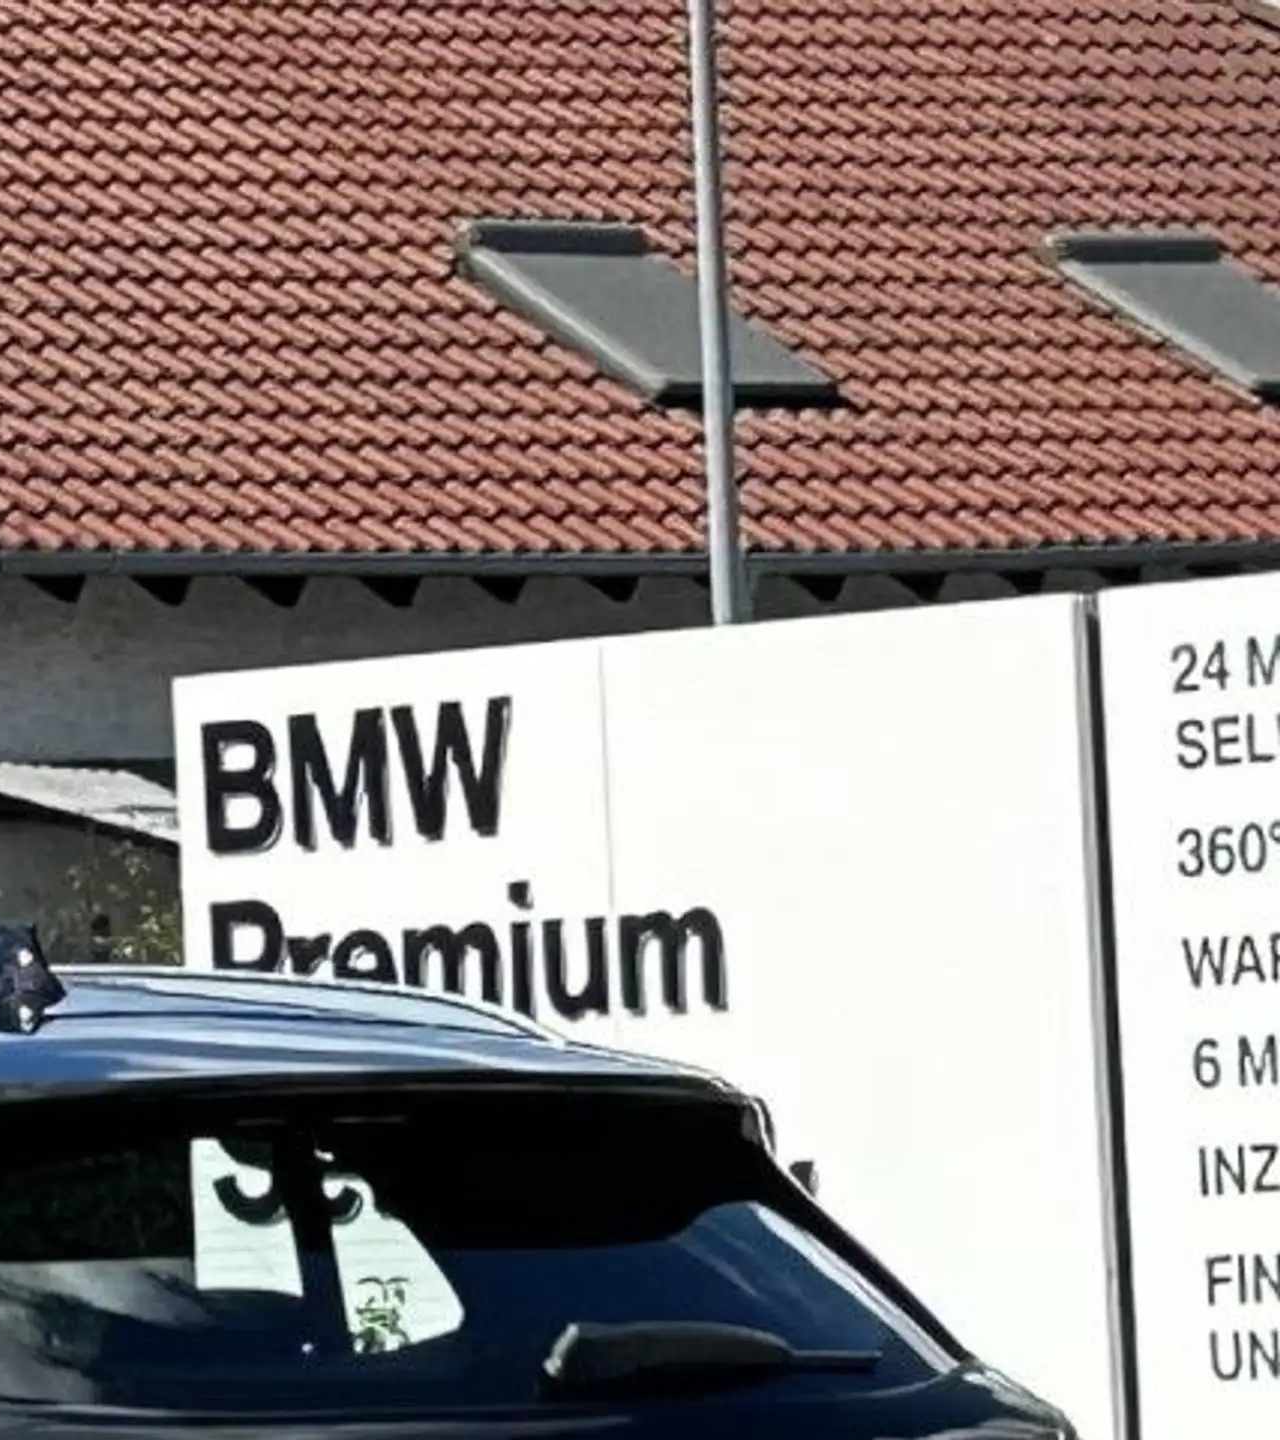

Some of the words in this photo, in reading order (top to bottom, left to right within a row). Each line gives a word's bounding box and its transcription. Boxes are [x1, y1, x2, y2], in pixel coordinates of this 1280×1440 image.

[1171, 639, 1231, 693] 24
[1176, 713, 1280, 770] SEL
[200, 696, 513, 856] BMW
[1193, 1037, 1222, 1089] 6
[1238, 1033, 1279, 1087] M
[1198, 1143, 1280, 1197] INZ
